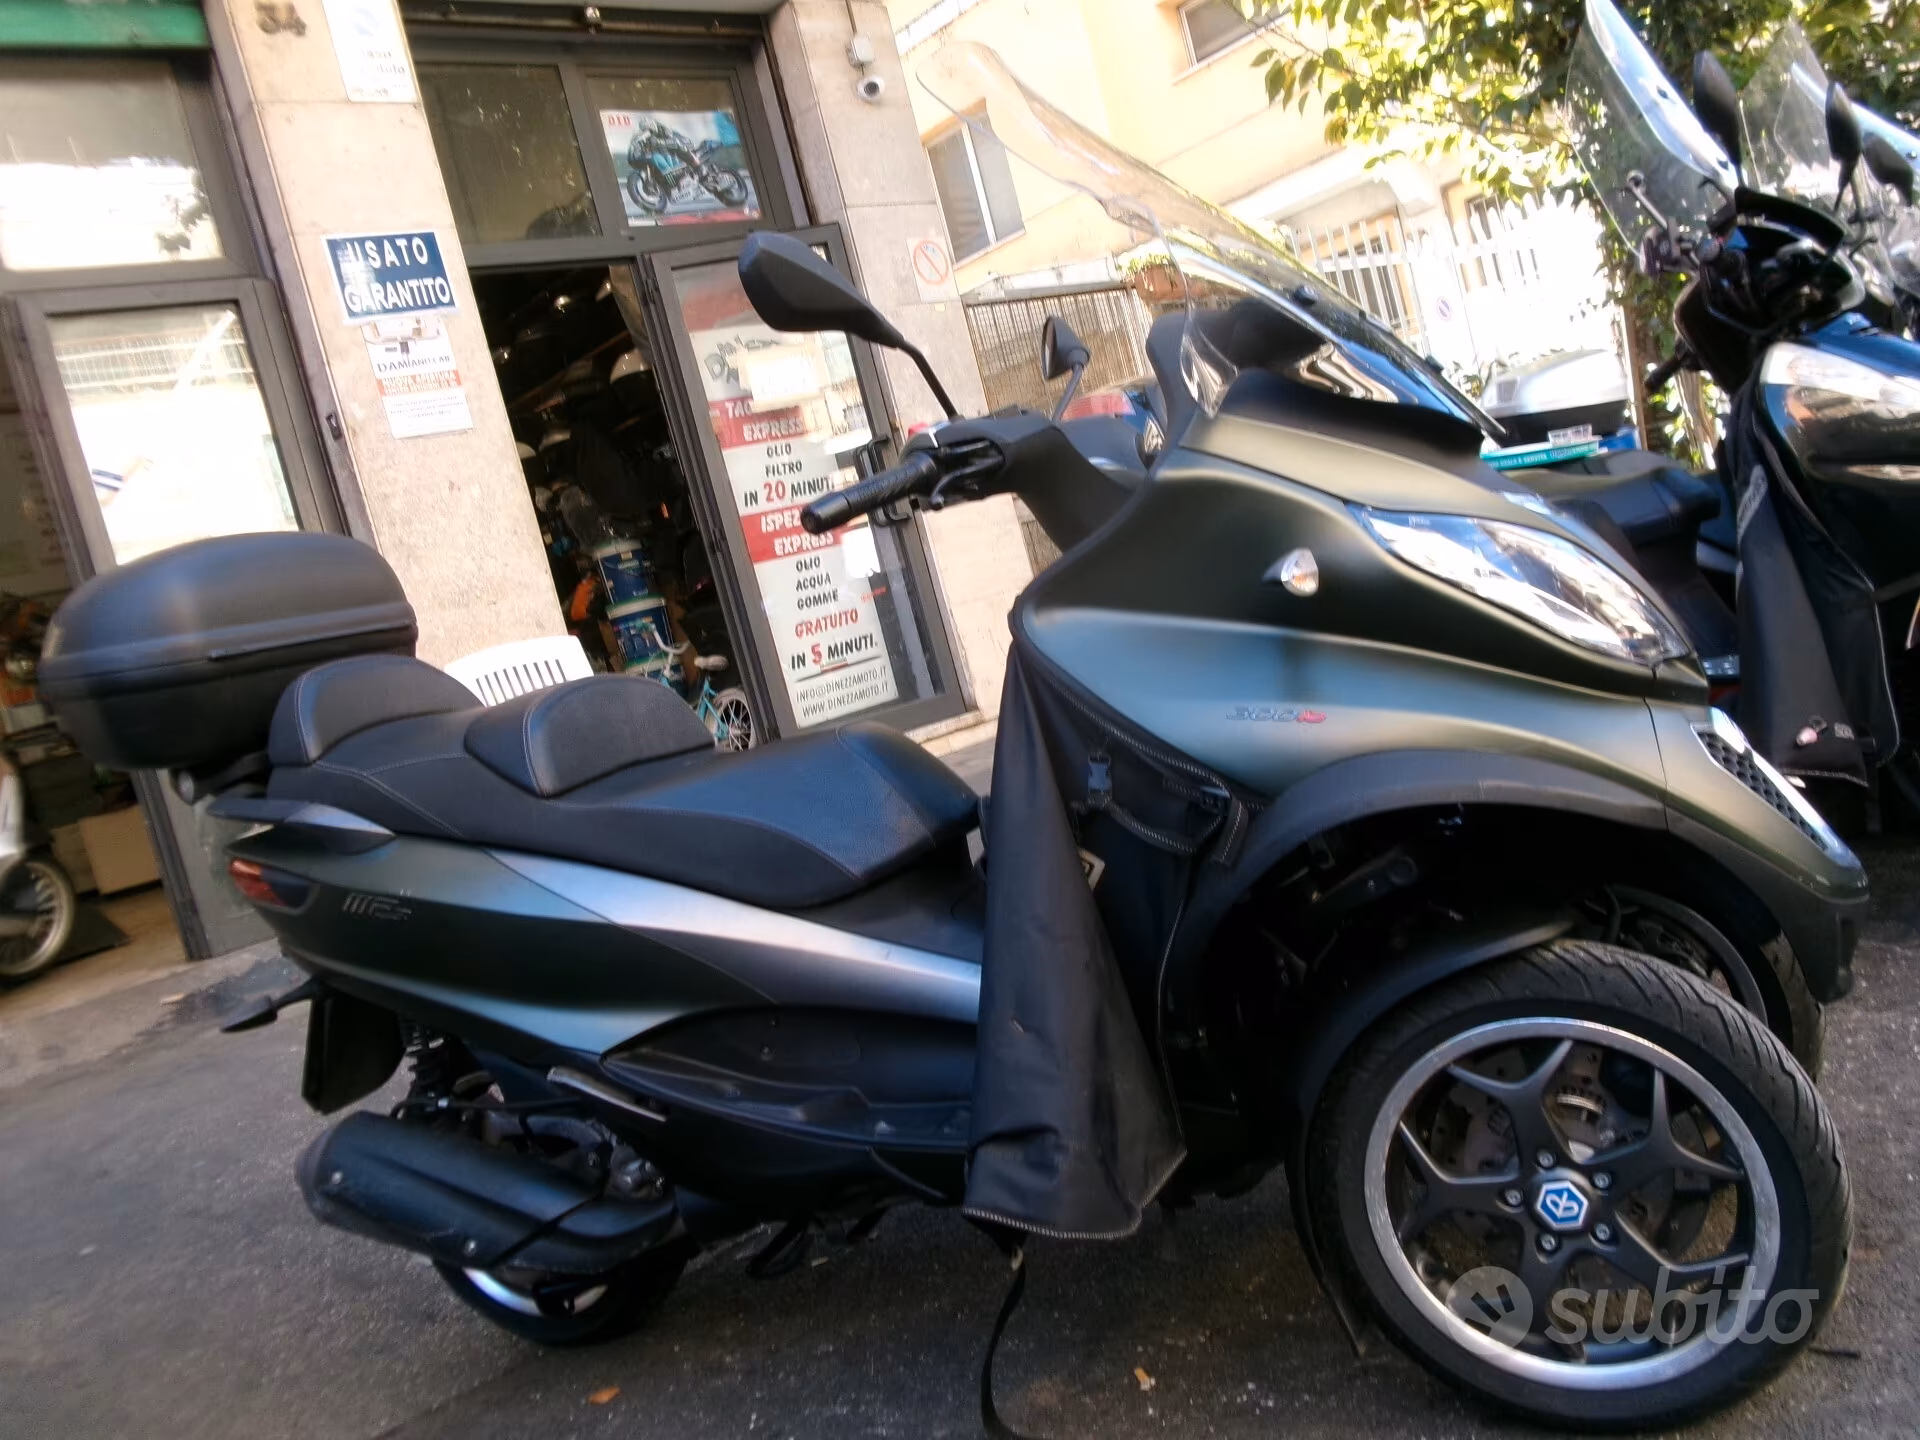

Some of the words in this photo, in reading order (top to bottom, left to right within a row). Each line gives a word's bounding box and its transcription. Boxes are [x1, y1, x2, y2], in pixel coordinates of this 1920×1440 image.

[345, 236, 428, 269] USATO
[344, 276, 450, 313] GARANTITO
[743, 418, 802, 442] EXPRESS
[766, 443, 792, 459] OLIO
[765, 460, 803, 477] FILTRO
[744, 490, 758, 507] IN
[763, 481, 786, 502] 20
[760, 507, 801, 533] ISPEZ
[774, 531, 834, 556] EXPRESS
[796, 556, 821, 572] OLIO
[796, 572, 831, 592] ACQUA
[797, 588, 839, 610] GOMME
[795, 608, 858, 638] GRATUITO
[791, 652, 806, 670] IN
[811, 643, 822, 665] 5
[796, 665, 887, 703] INFO@DINEZZAMOTO.IT
[802, 682, 888, 718] WWW.DINEZZAMOTO.IT
